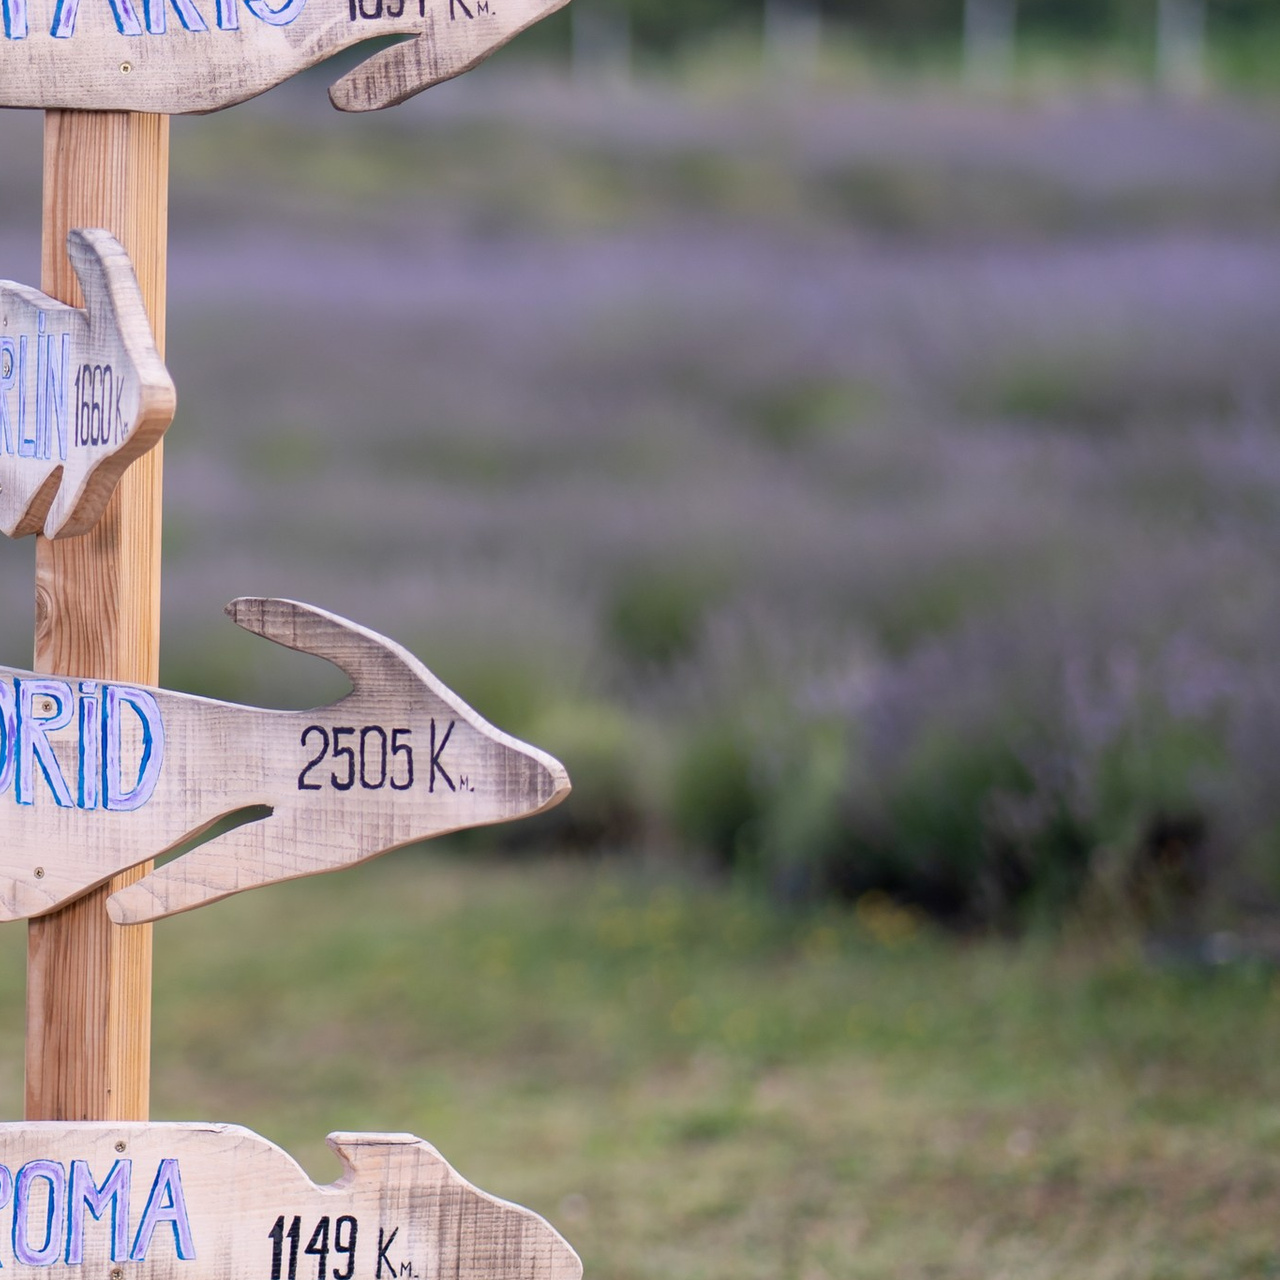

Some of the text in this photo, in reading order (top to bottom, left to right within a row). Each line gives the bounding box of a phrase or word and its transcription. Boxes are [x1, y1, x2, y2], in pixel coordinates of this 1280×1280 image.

[75, 364, 112, 447] 1660
[298, 725, 414, 791] 2505
[268, 1215, 358, 1280] 1149
